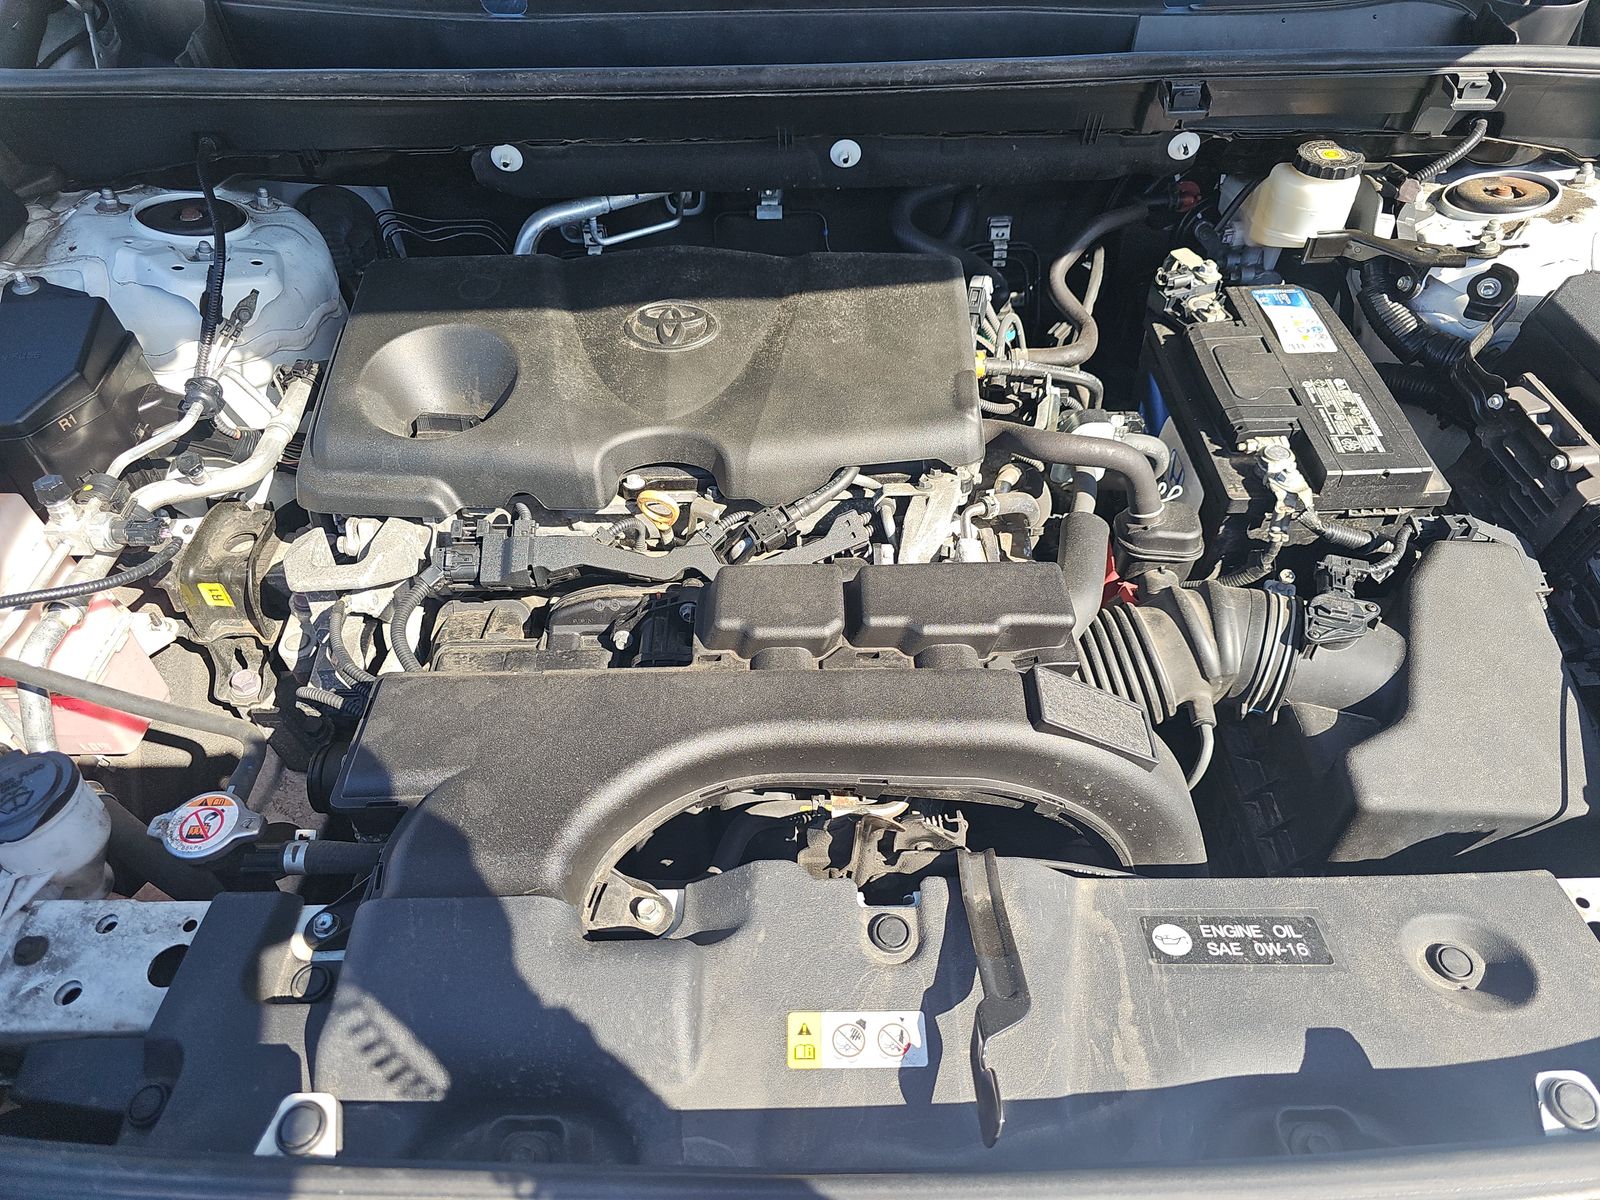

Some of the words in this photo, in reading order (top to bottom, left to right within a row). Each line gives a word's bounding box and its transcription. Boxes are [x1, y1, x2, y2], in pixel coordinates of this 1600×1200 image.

[58, 413, 78, 432] R1
[208, 588, 225, 601] R1
[1200, 925, 1263, 939] ENGINE
[1272, 925, 1303, 939] OIL
[1207, 942, 1244, 957] SAE
[1254, 942, 1309, 957] 0W-16
